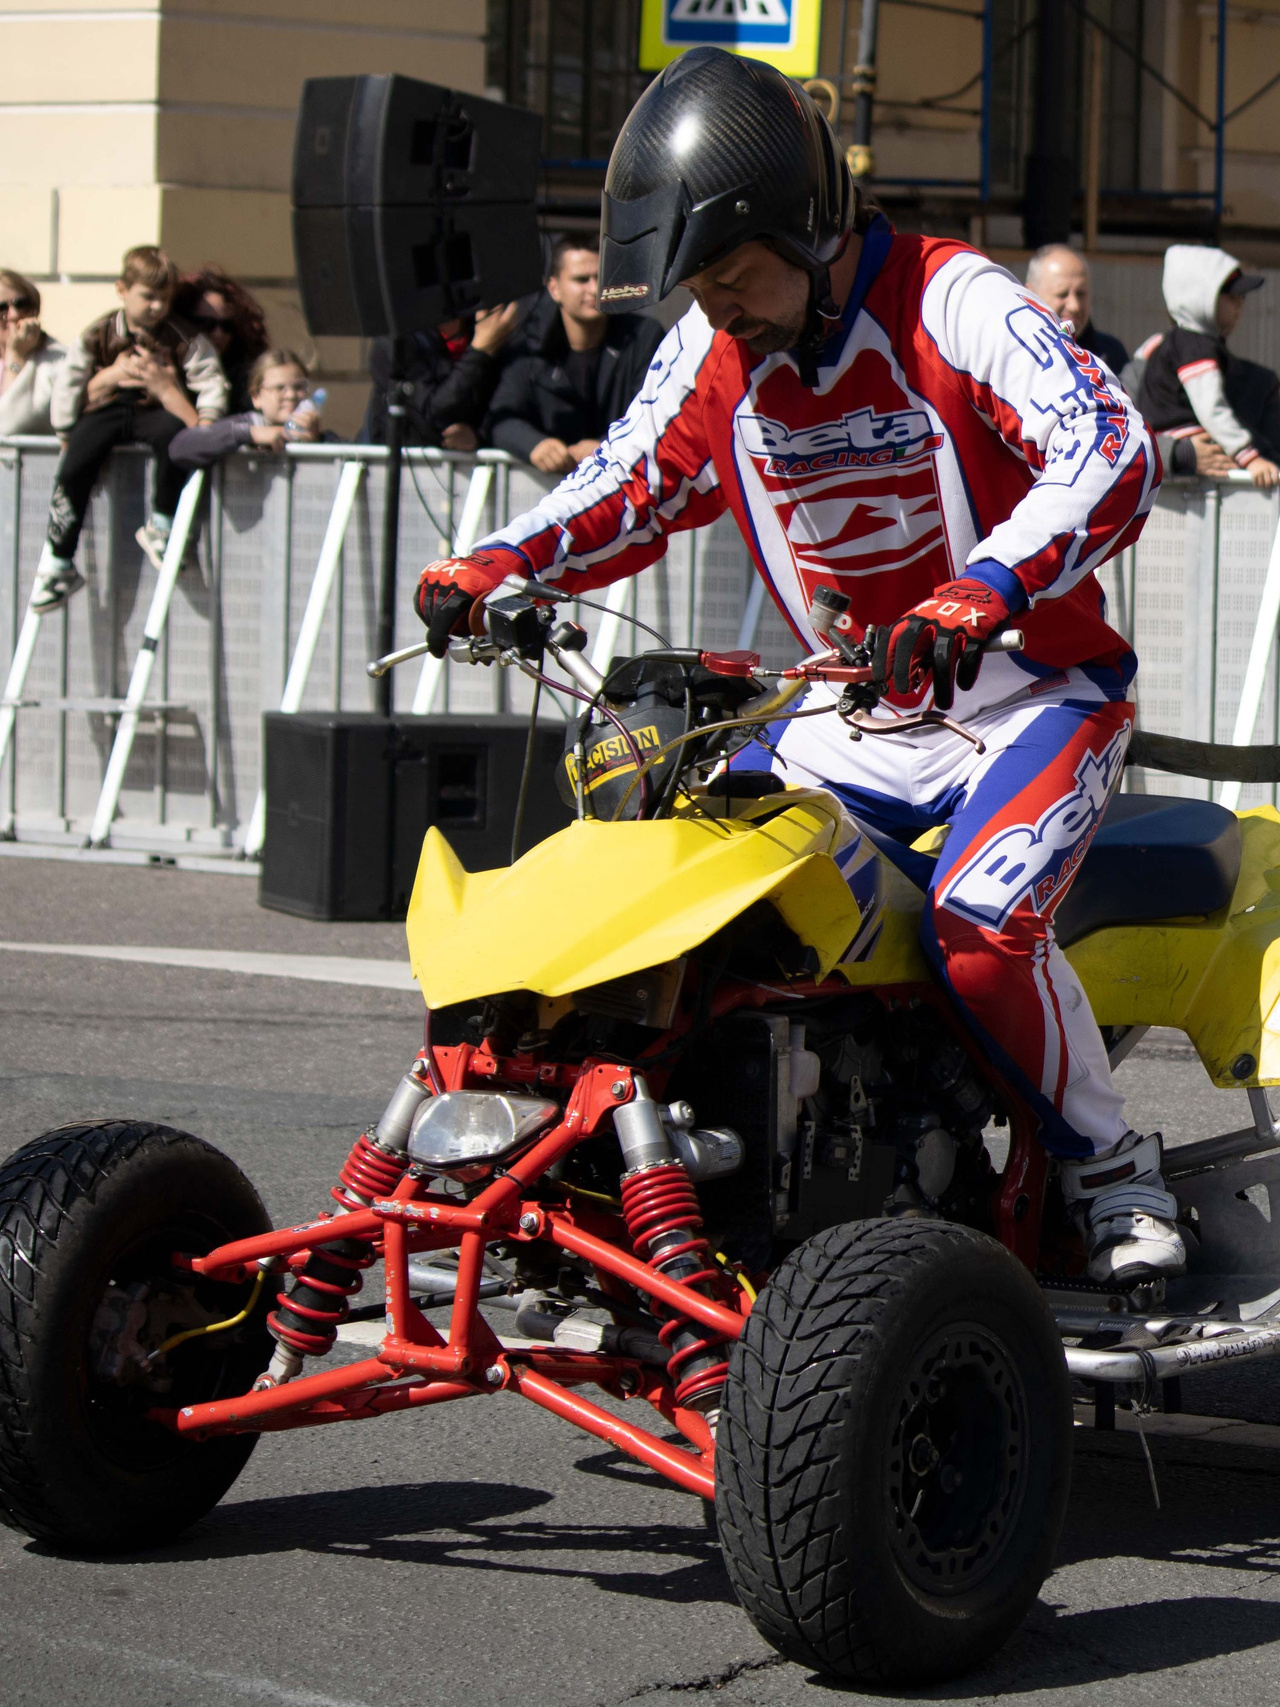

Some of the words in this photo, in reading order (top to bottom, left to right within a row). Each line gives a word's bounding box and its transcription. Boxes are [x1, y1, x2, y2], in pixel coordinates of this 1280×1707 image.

[738, 407, 934, 458] Beta
[769, 449, 892, 475] RACING
[913, 599, 986, 628] FOX
[567, 728, 656, 783] PCISION
[938, 718, 1134, 930] Beta
[1035, 818, 1099, 905] RACI
